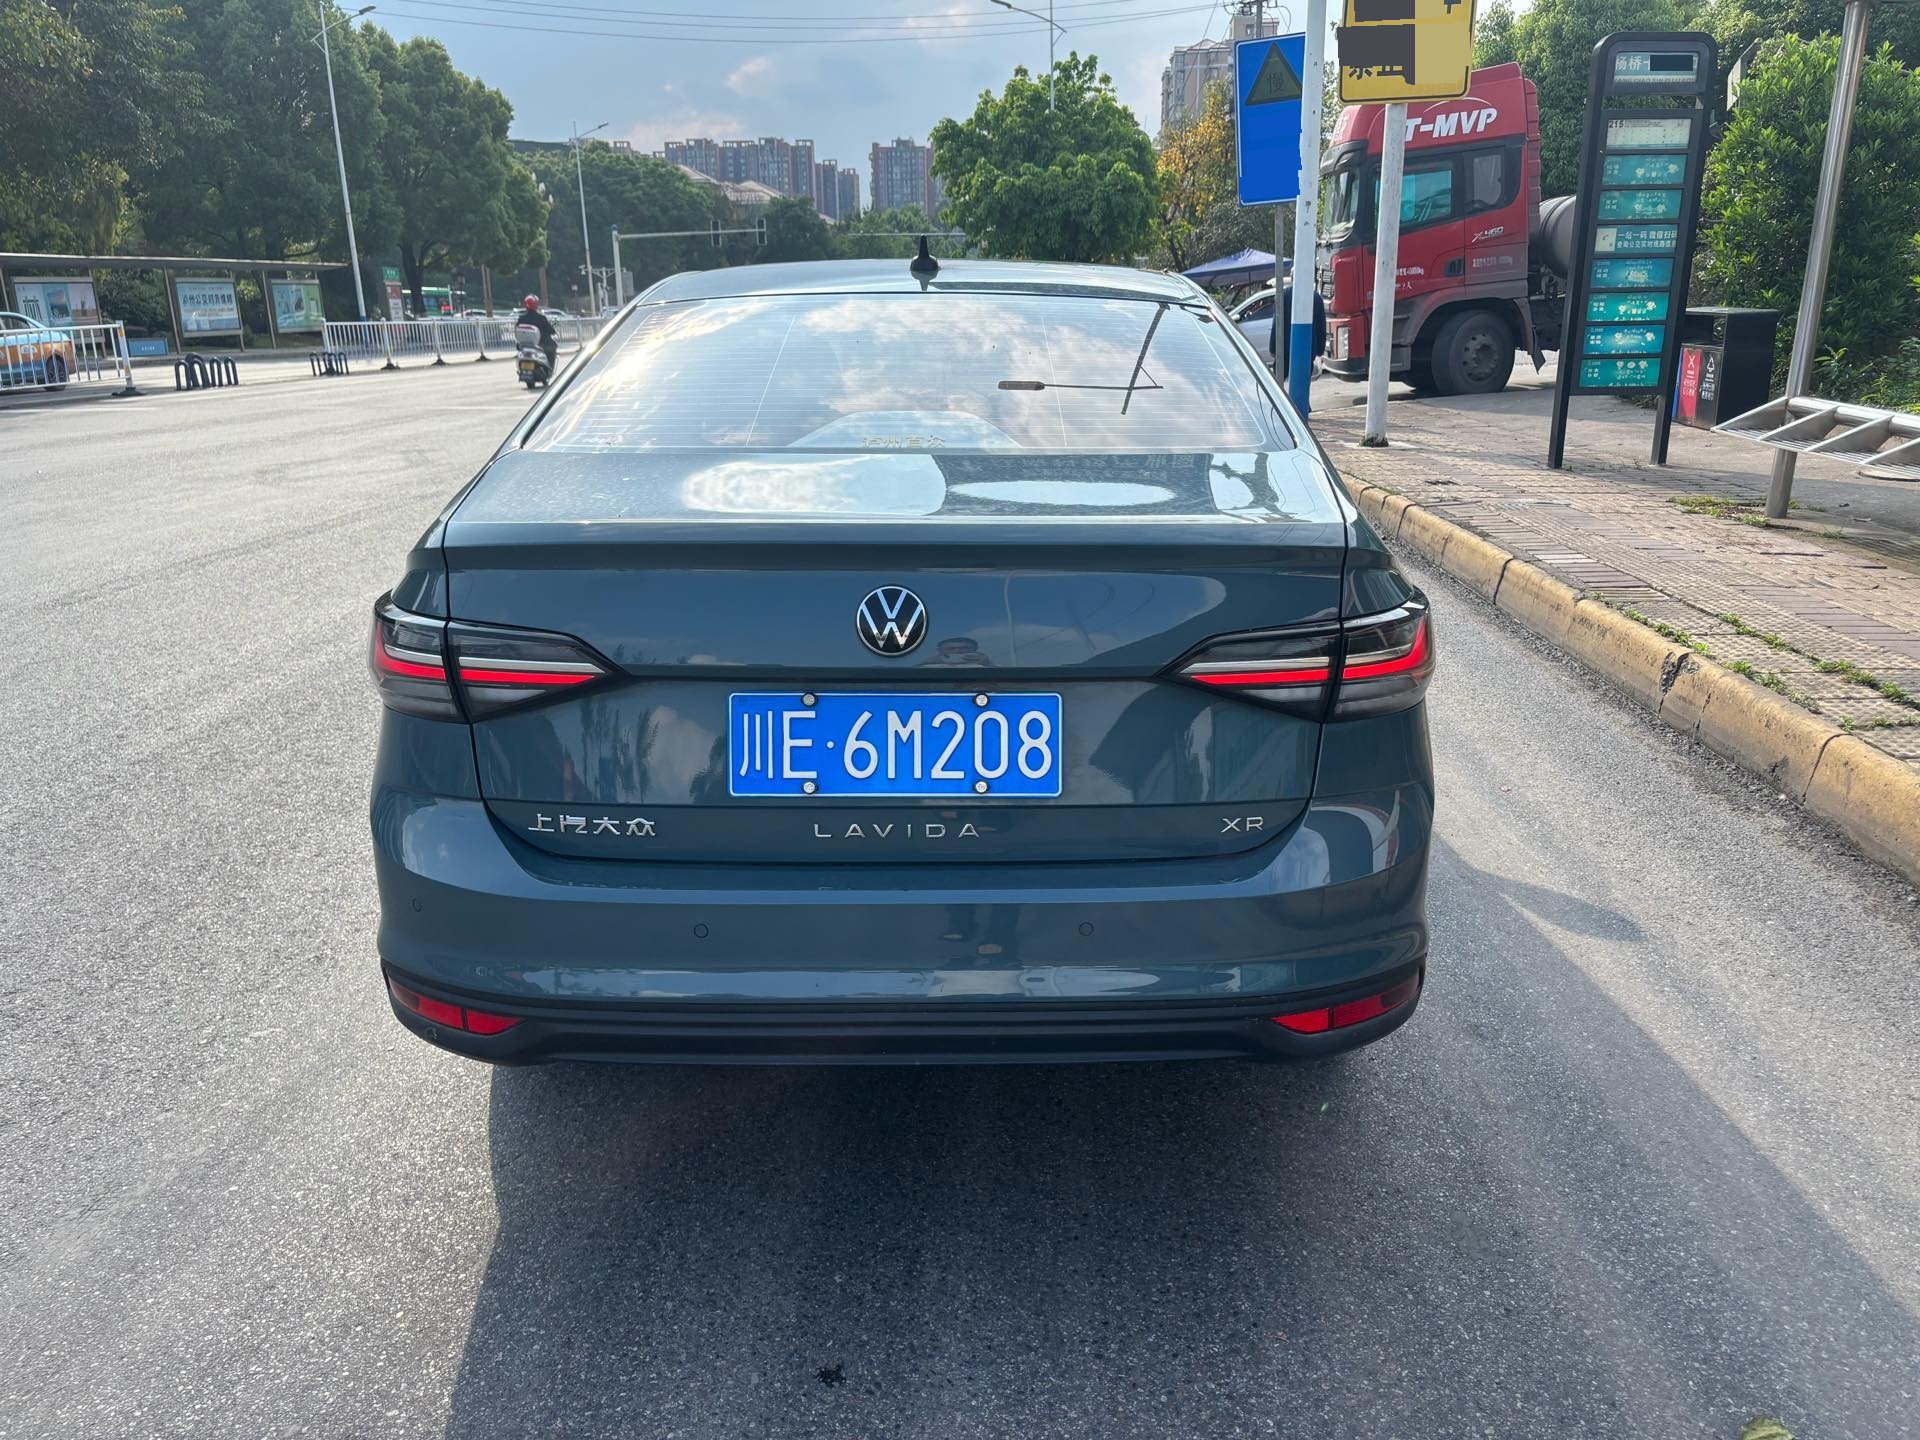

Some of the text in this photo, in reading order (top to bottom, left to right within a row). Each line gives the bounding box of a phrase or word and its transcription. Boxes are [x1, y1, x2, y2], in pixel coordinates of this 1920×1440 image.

[1405, 107, 1497, 142] T-MVP
[528, 813, 656, 836] 上汽大众
[813, 822, 980, 838] LAVIDA
[1220, 816, 1264, 833] XR
